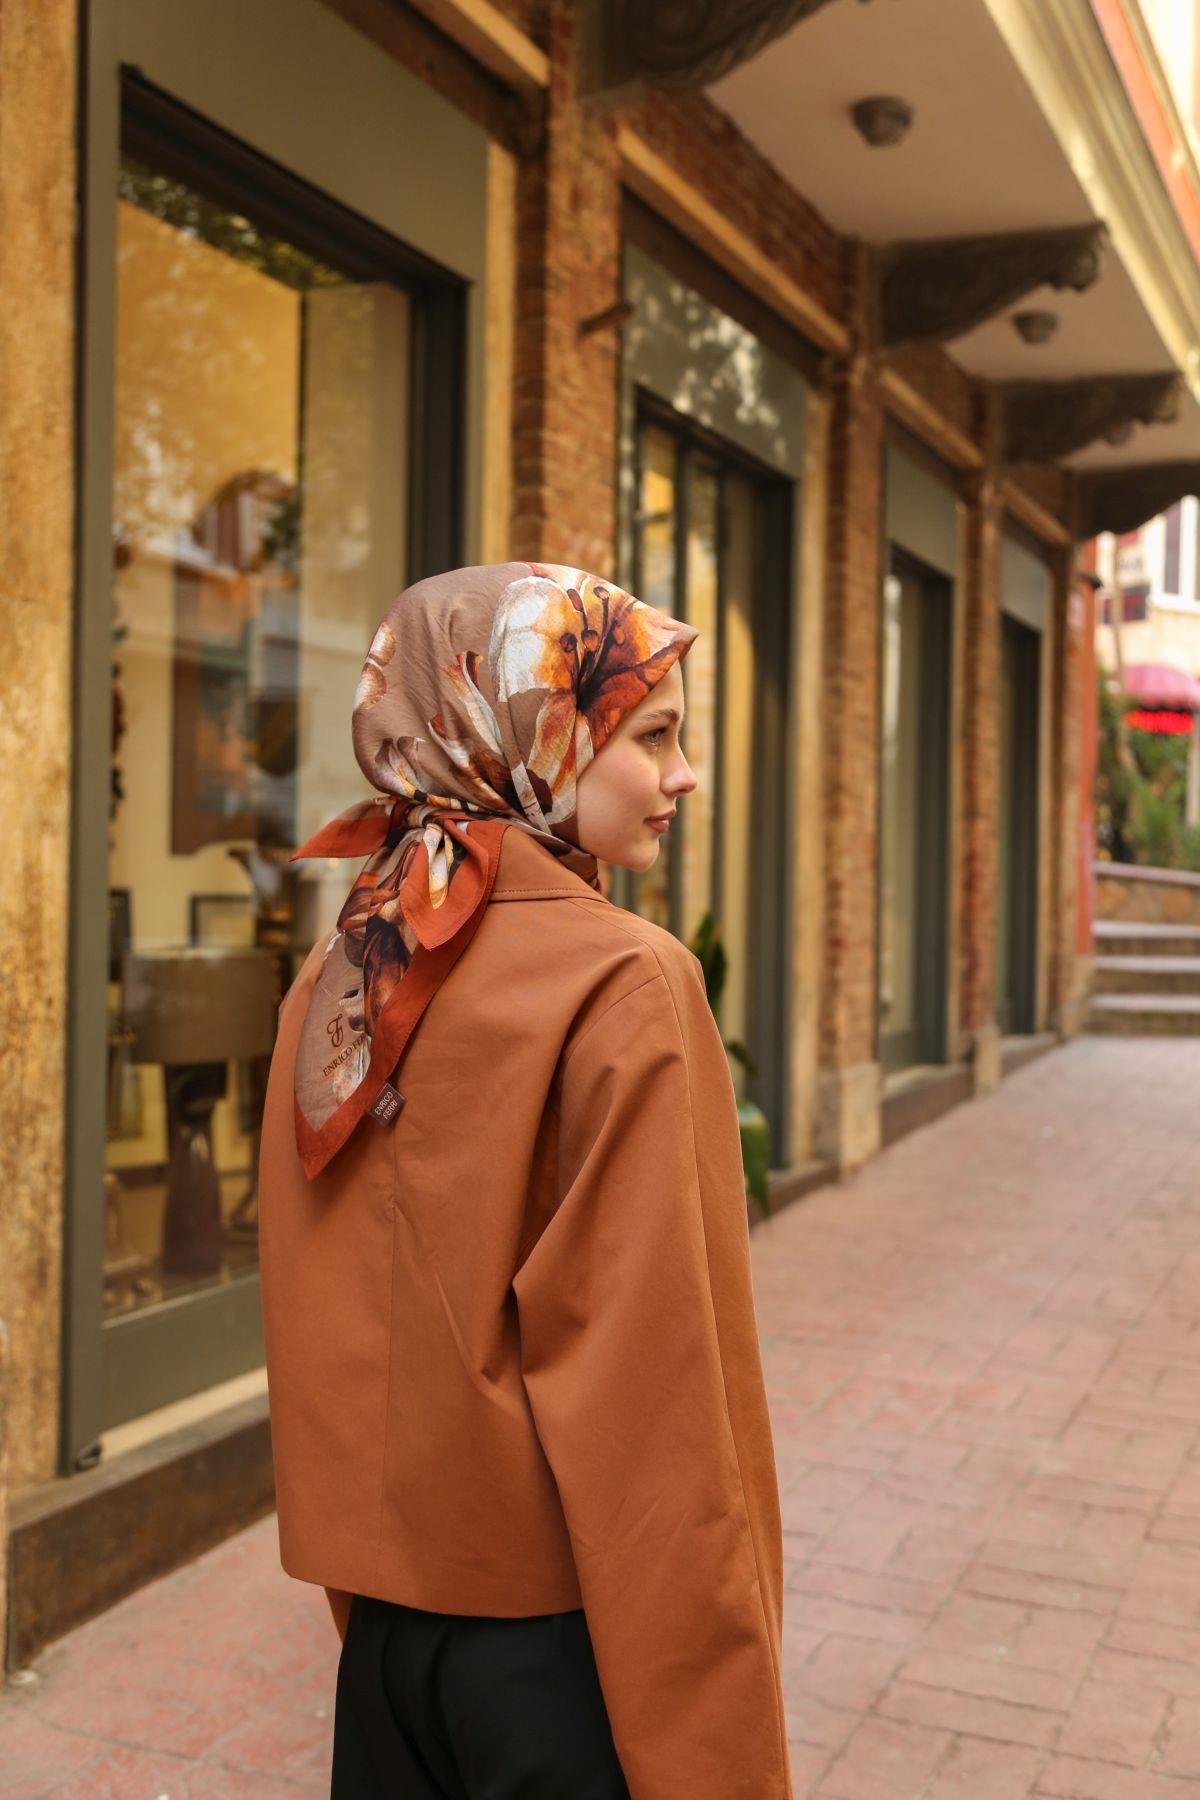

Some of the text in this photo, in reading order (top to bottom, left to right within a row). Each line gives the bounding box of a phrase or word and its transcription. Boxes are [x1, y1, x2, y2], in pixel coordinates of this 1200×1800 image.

[323, 1032, 366, 1077] ENRICO FER
[374, 1091, 393, 1116] ENRICO
[382, 1099, 398, 1120] FERRI
